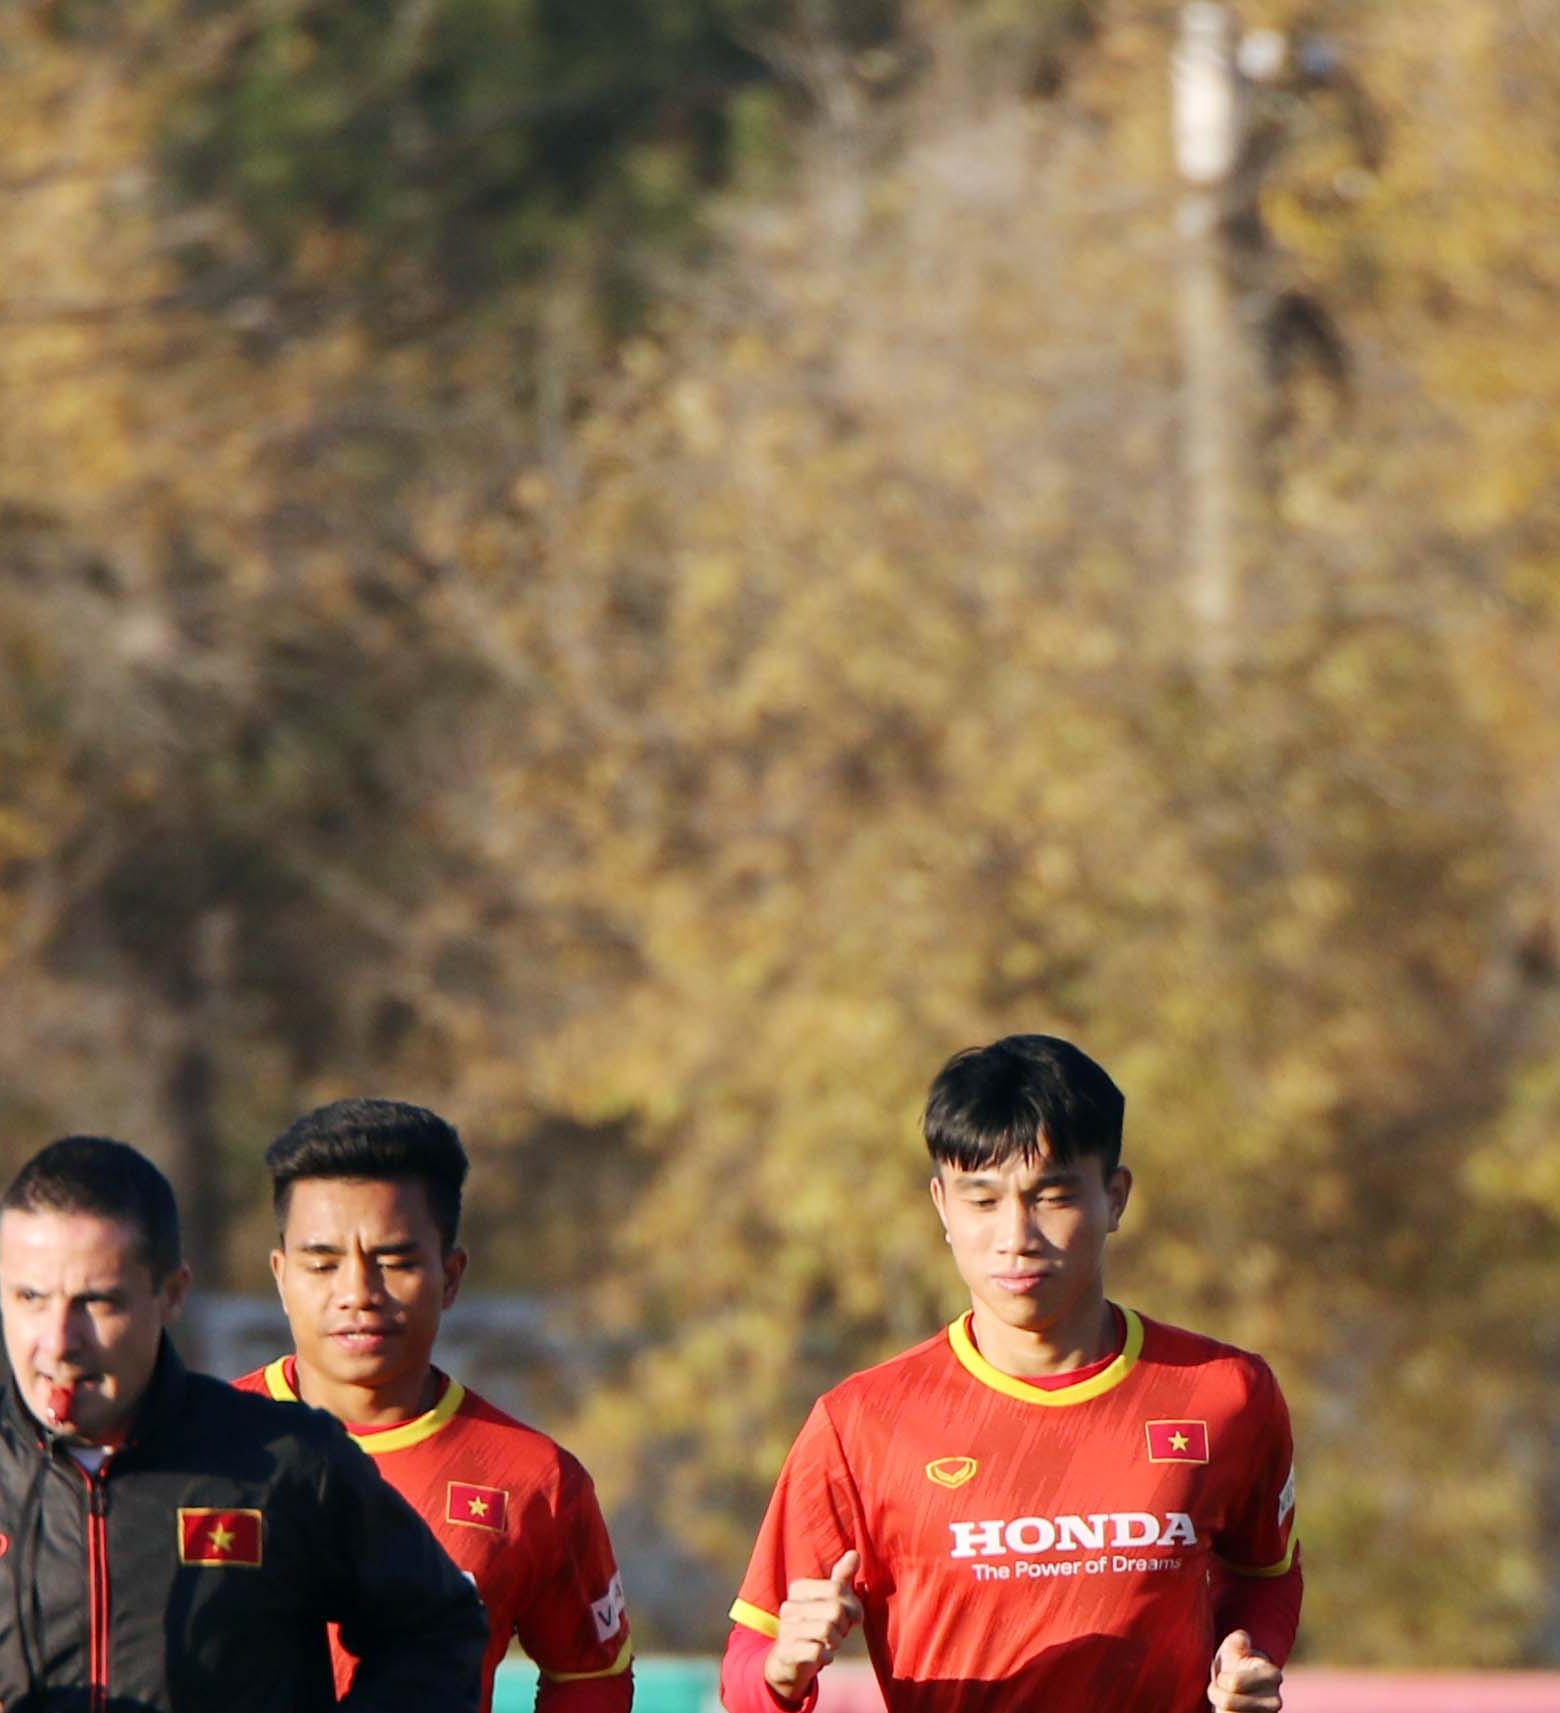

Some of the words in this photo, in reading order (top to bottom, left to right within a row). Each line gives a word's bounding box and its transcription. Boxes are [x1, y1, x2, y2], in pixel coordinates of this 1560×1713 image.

[949, 1512, 1198, 1558] HONDA
[971, 1563, 1011, 1581] The
[1014, 1558, 1082, 1579] Power
[1084, 1556, 1109, 1575] of
[1111, 1554, 1183, 1573] Dreams
